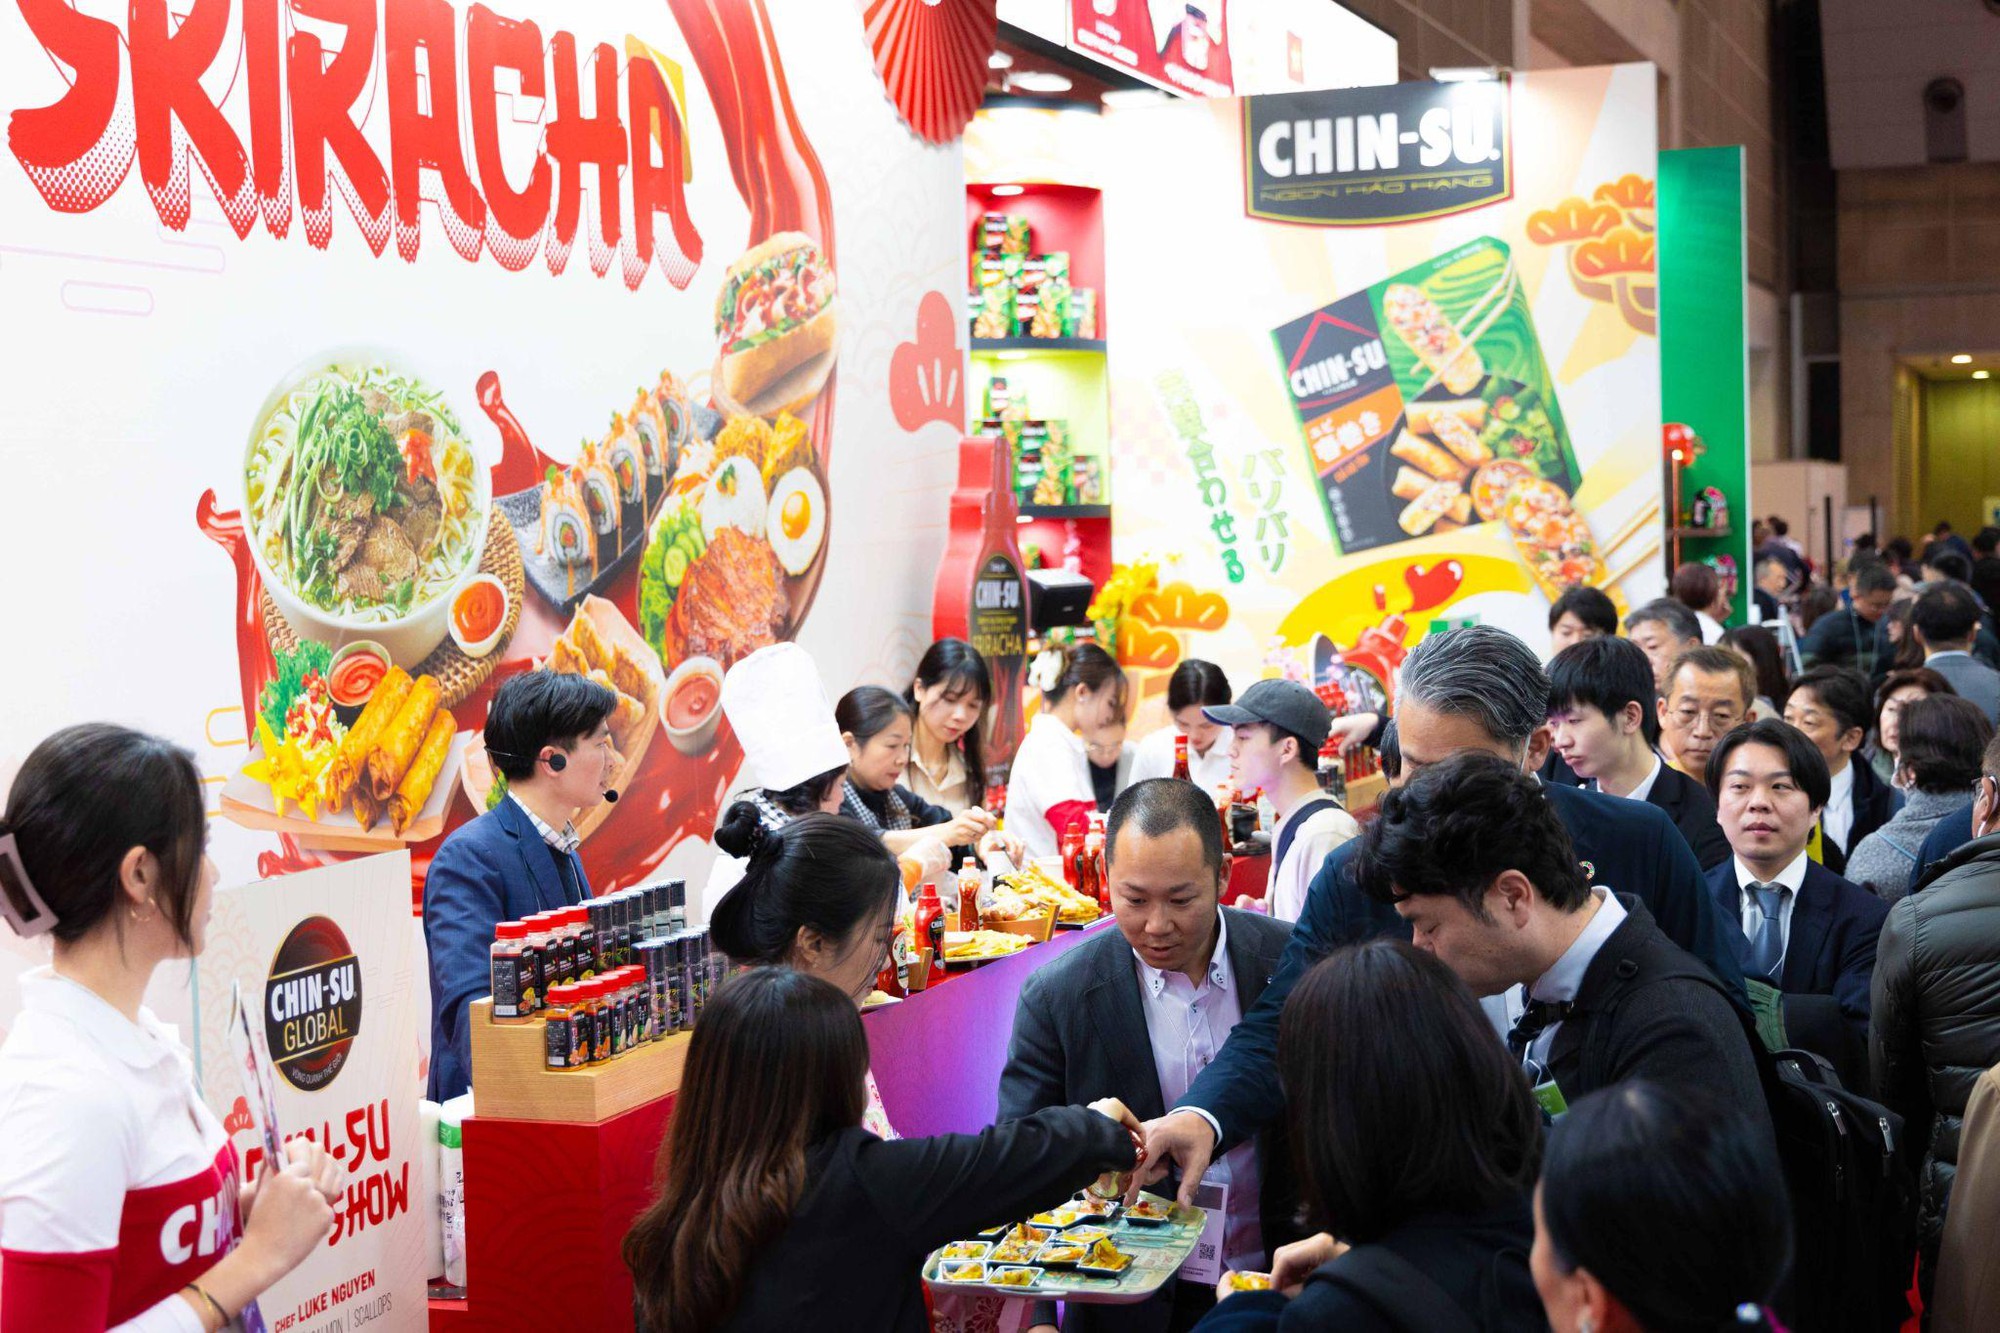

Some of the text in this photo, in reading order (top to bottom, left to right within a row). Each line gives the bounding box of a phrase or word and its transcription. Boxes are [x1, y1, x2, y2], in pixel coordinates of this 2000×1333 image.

[8, 0, 704, 291] SRIRACHA
[1258, 102, 1497, 179] CHIN-SU
[1289, 338, 1388, 399] CHIN-SU
[975, 580, 1020, 609] CHIN-SU
[270, 963, 356, 1023] CHIN-SU
[283, 1006, 349, 1052] GLOBAL
[328, 1161, 410, 1247] SHOW
[274, 1268, 376, 1333] CHEF LUKE NGUYEN
[354, 1292, 393, 1328] SCALLOPS
